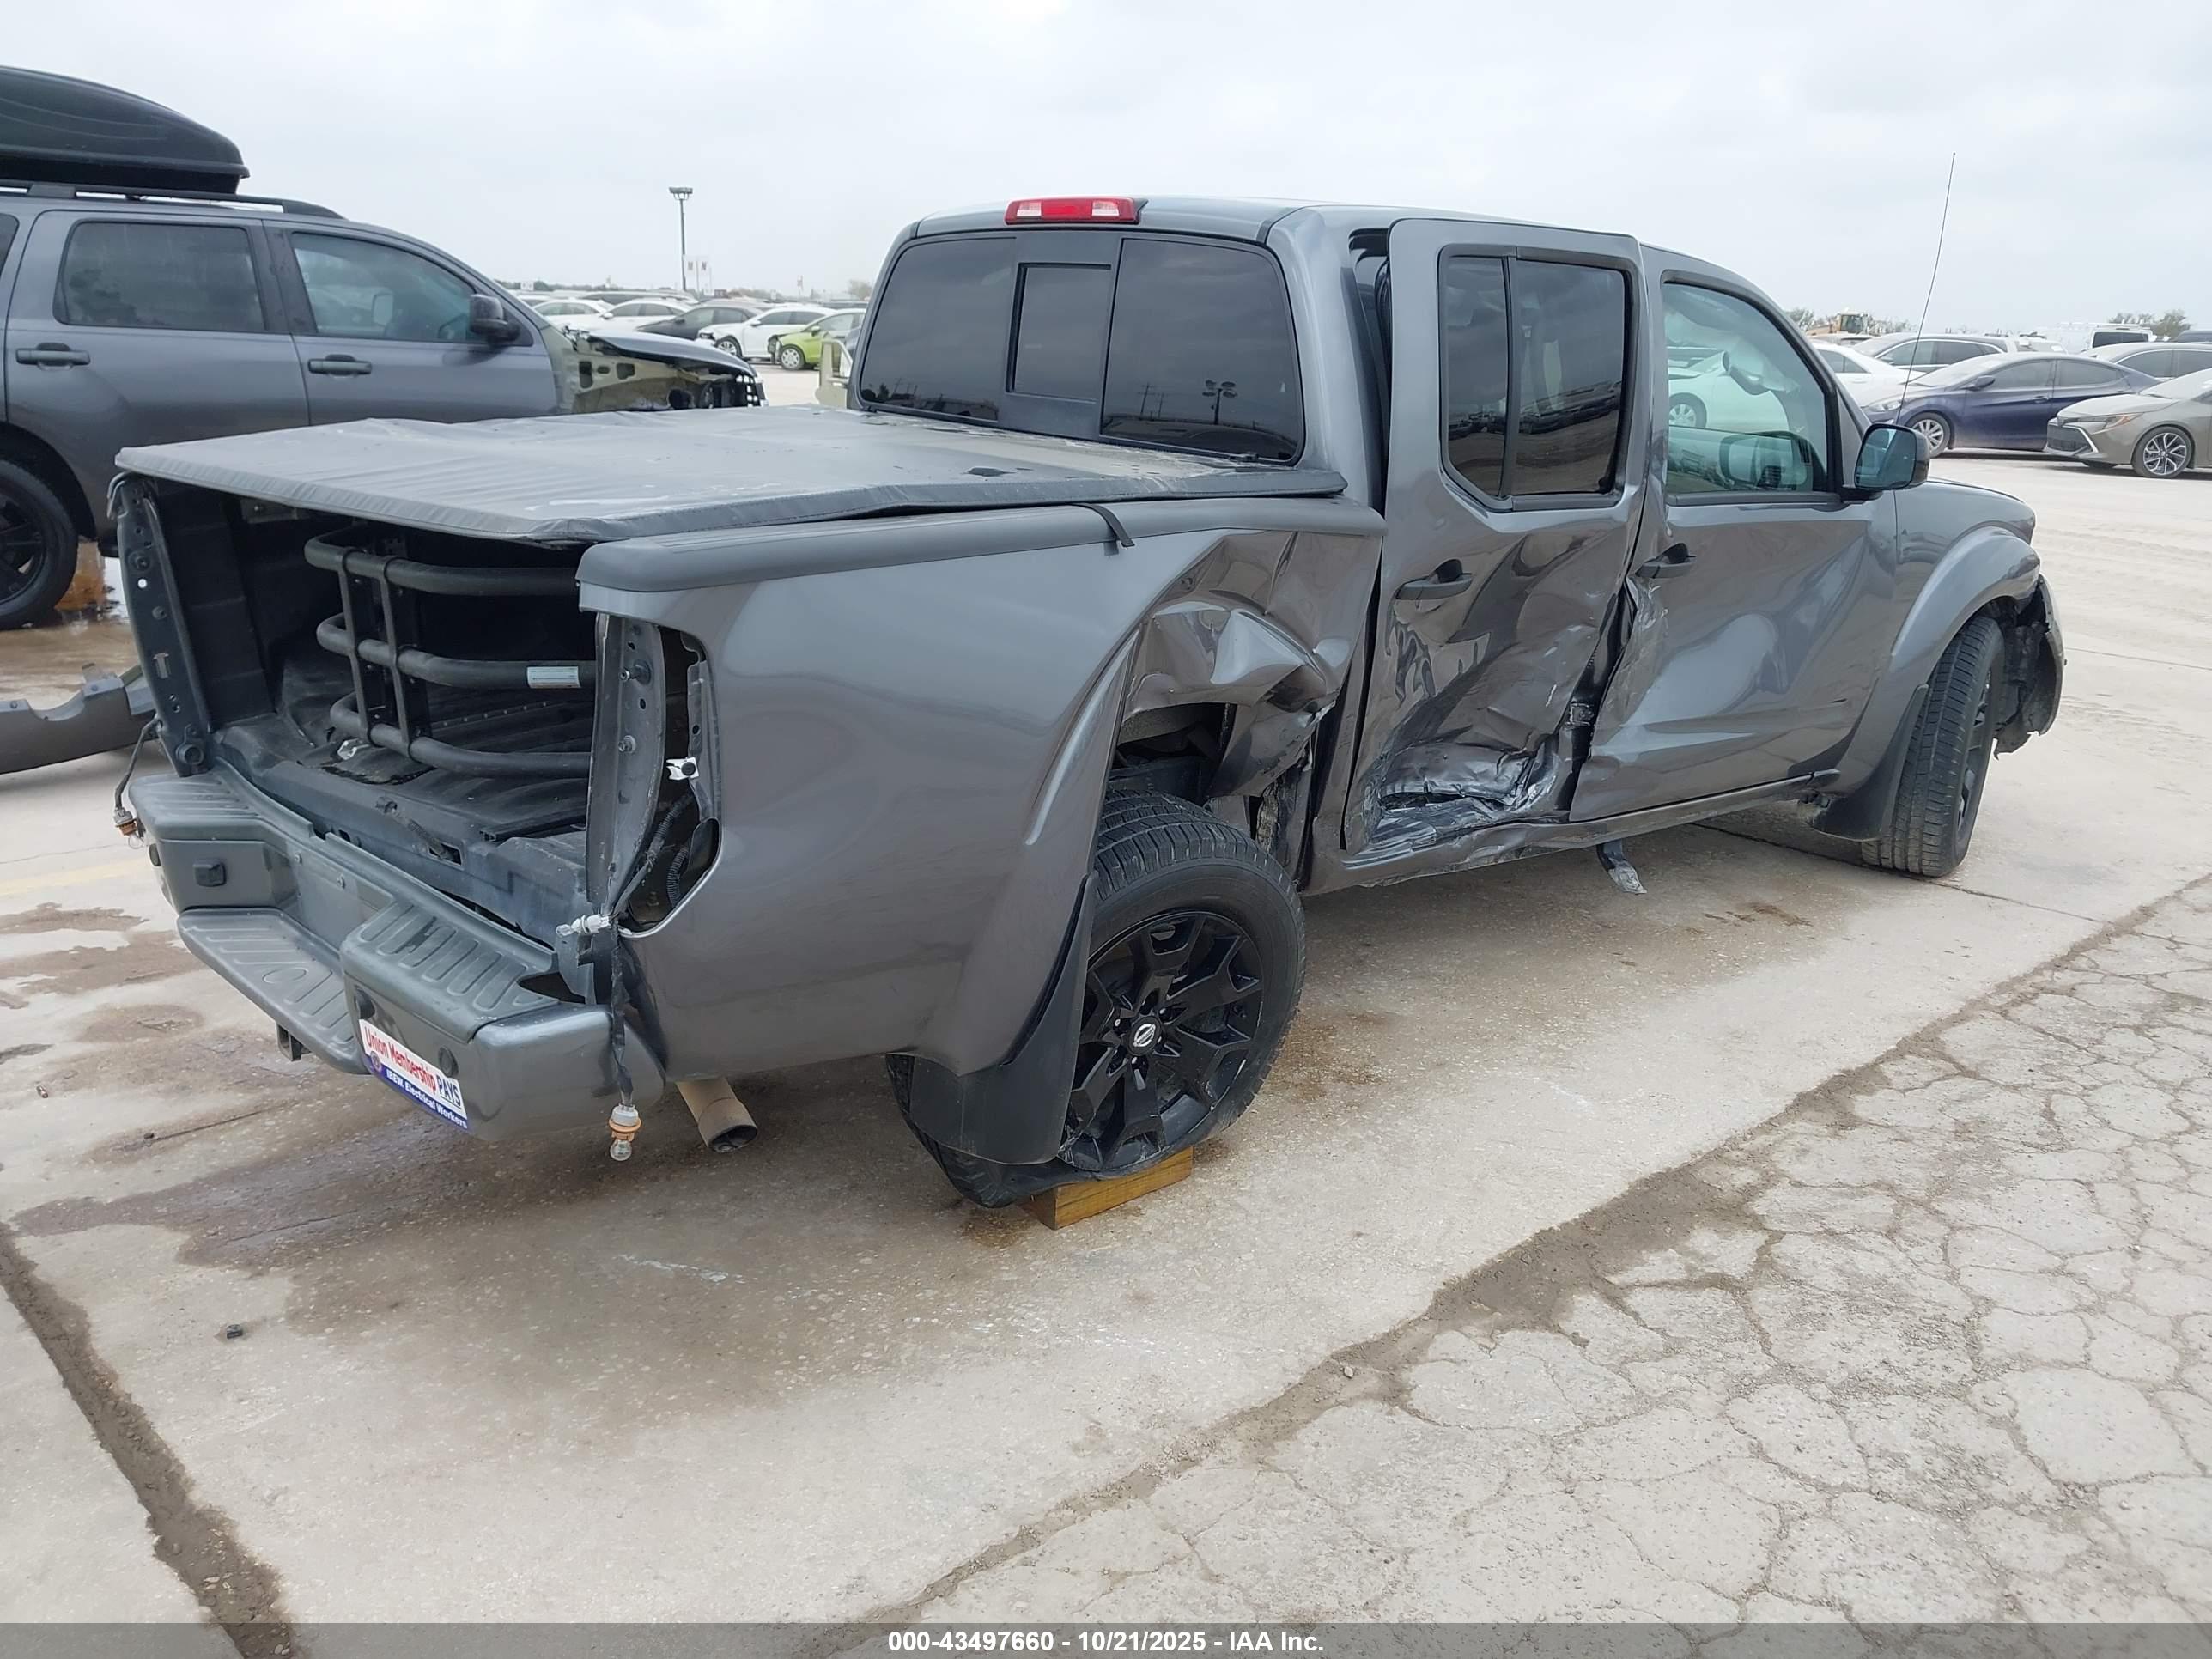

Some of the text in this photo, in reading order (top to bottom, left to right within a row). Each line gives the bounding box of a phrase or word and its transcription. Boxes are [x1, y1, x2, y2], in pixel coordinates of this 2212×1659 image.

[364, 1026, 389, 1059] Union
[388, 1042, 436, 1096] Membership
[436, 1074, 461, 1108] PAYS
[404, 1081, 436, 1110] Electrical
[436, 1103, 467, 1129] Workers
